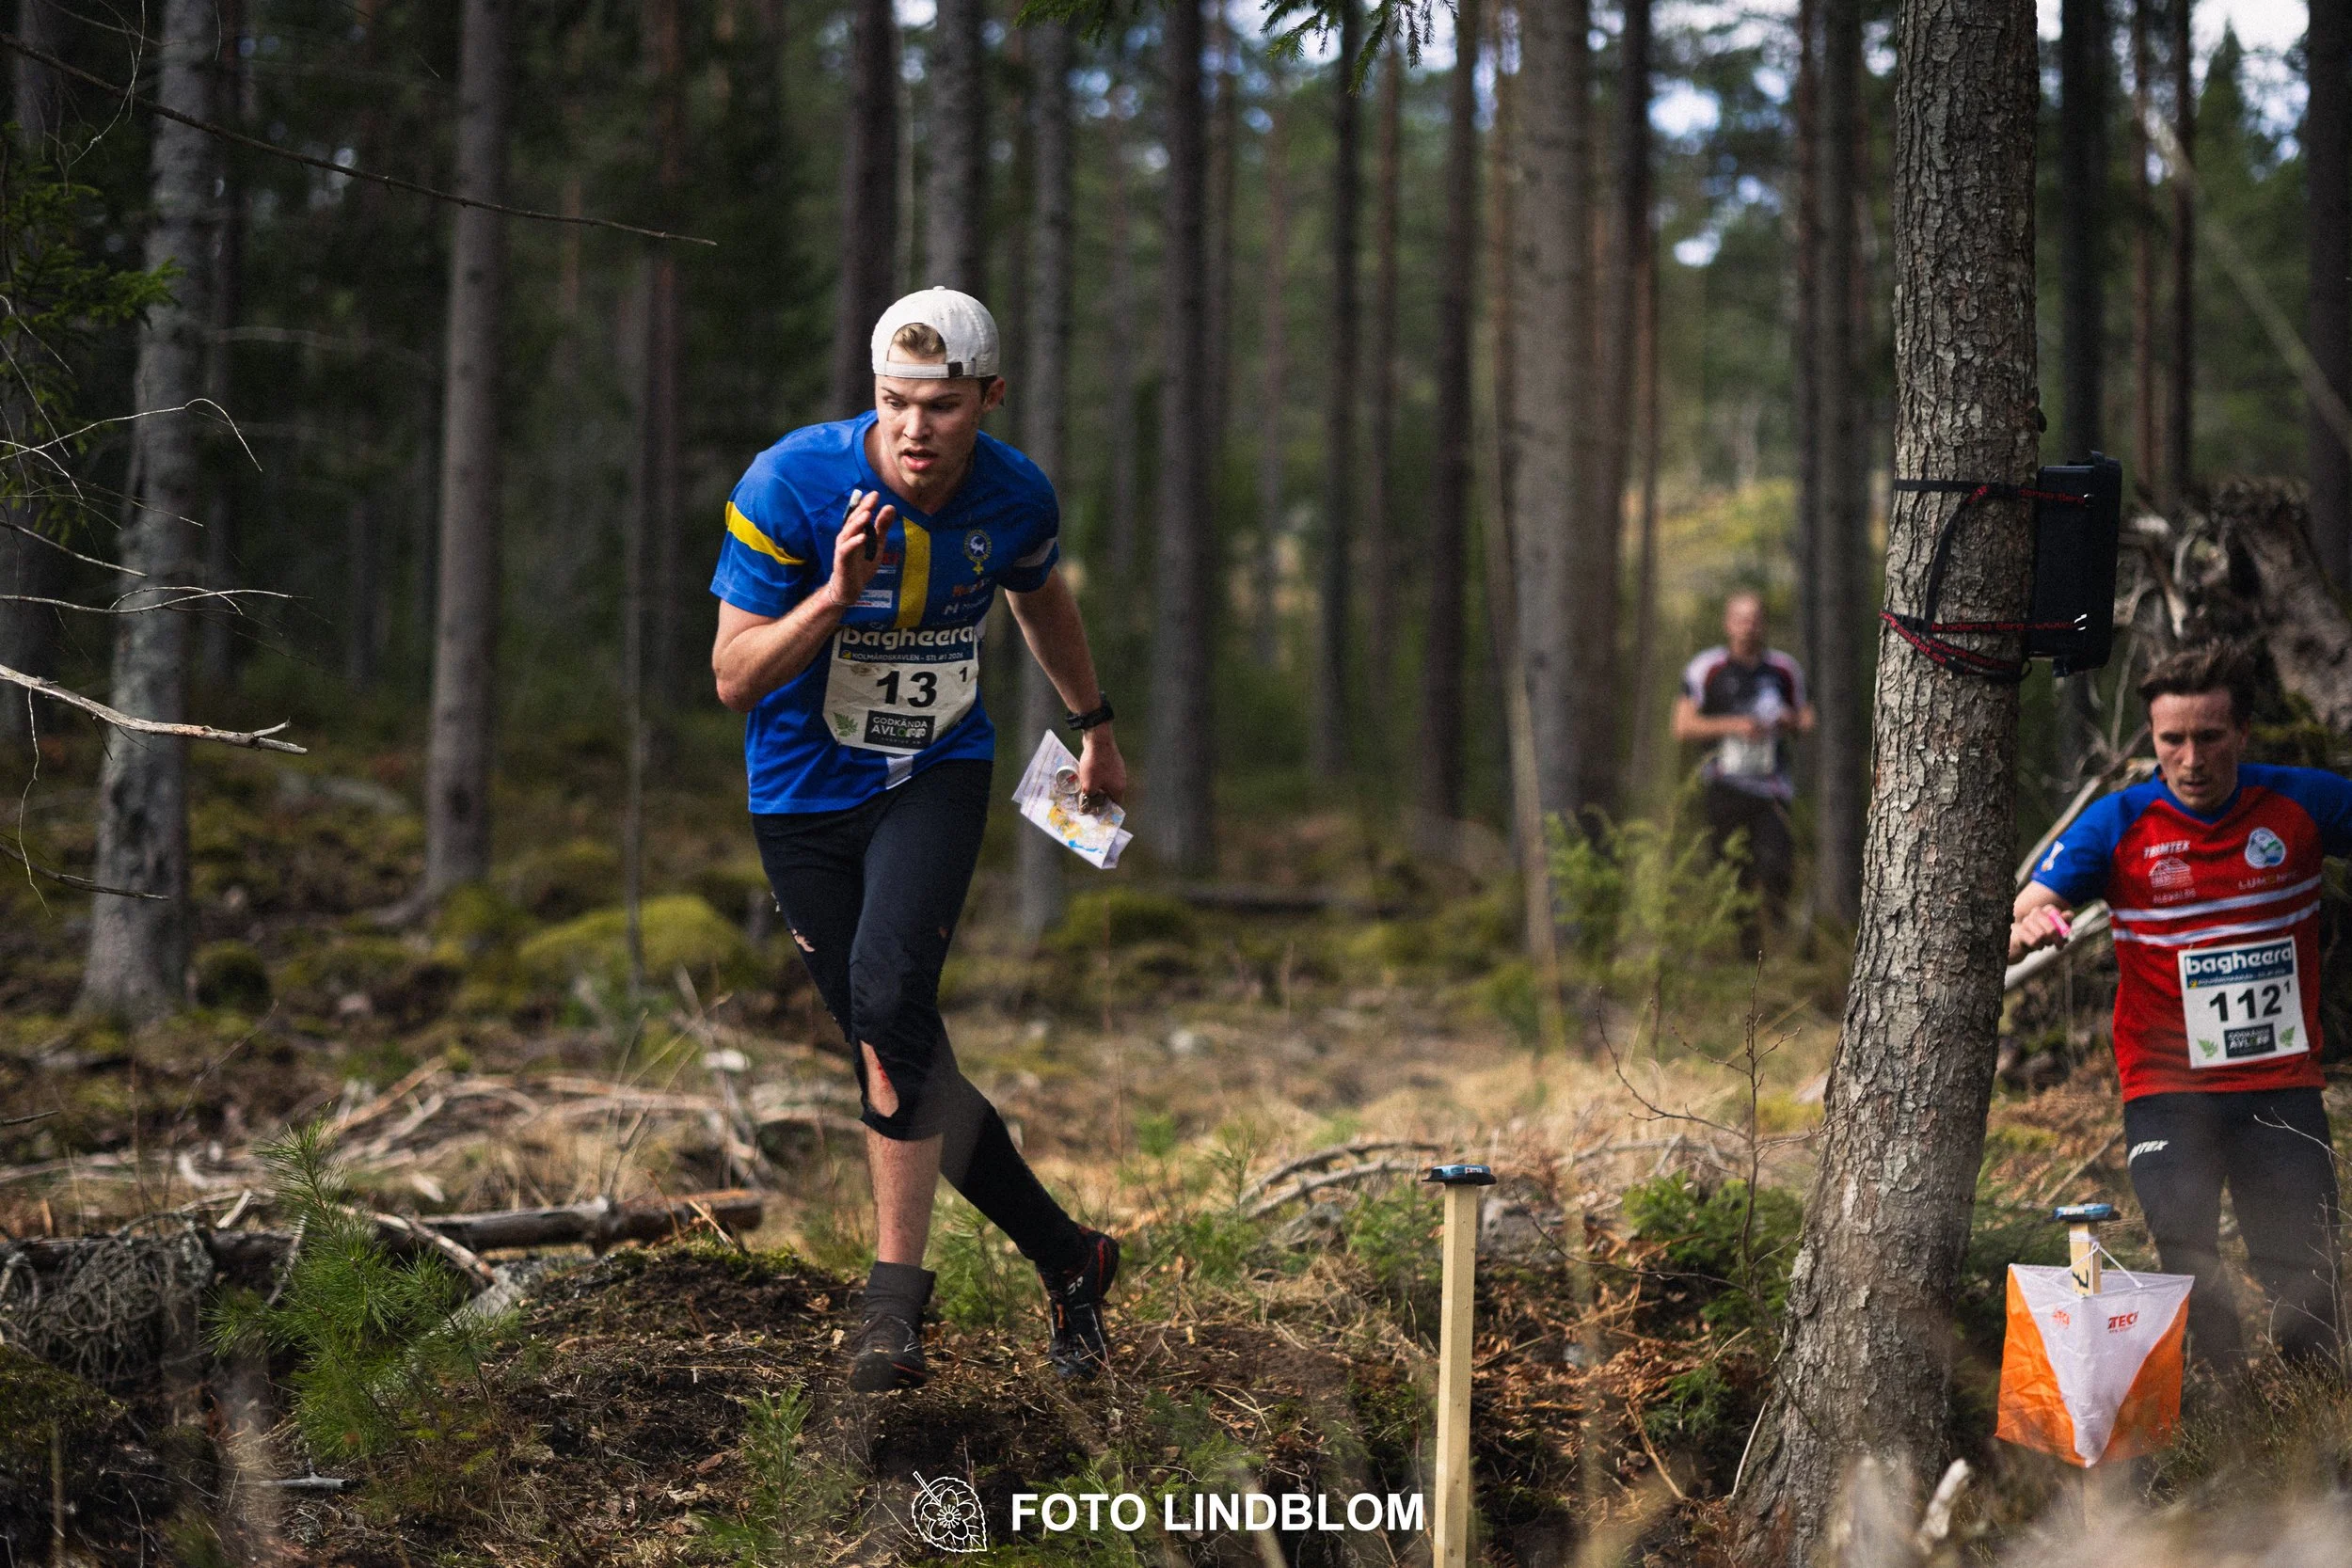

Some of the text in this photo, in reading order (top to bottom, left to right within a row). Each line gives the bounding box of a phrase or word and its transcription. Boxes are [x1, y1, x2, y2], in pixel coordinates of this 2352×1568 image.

[842, 626, 975, 651] bagheera
[959, 666, 968, 683] 1
[876, 671, 938, 708] 13
[873, 717, 929, 728] GODKÄNDA
[2185, 946, 2292, 975] bagheera
[2283, 980, 2291, 994] 1
[2209, 983, 2283, 1022] 112
